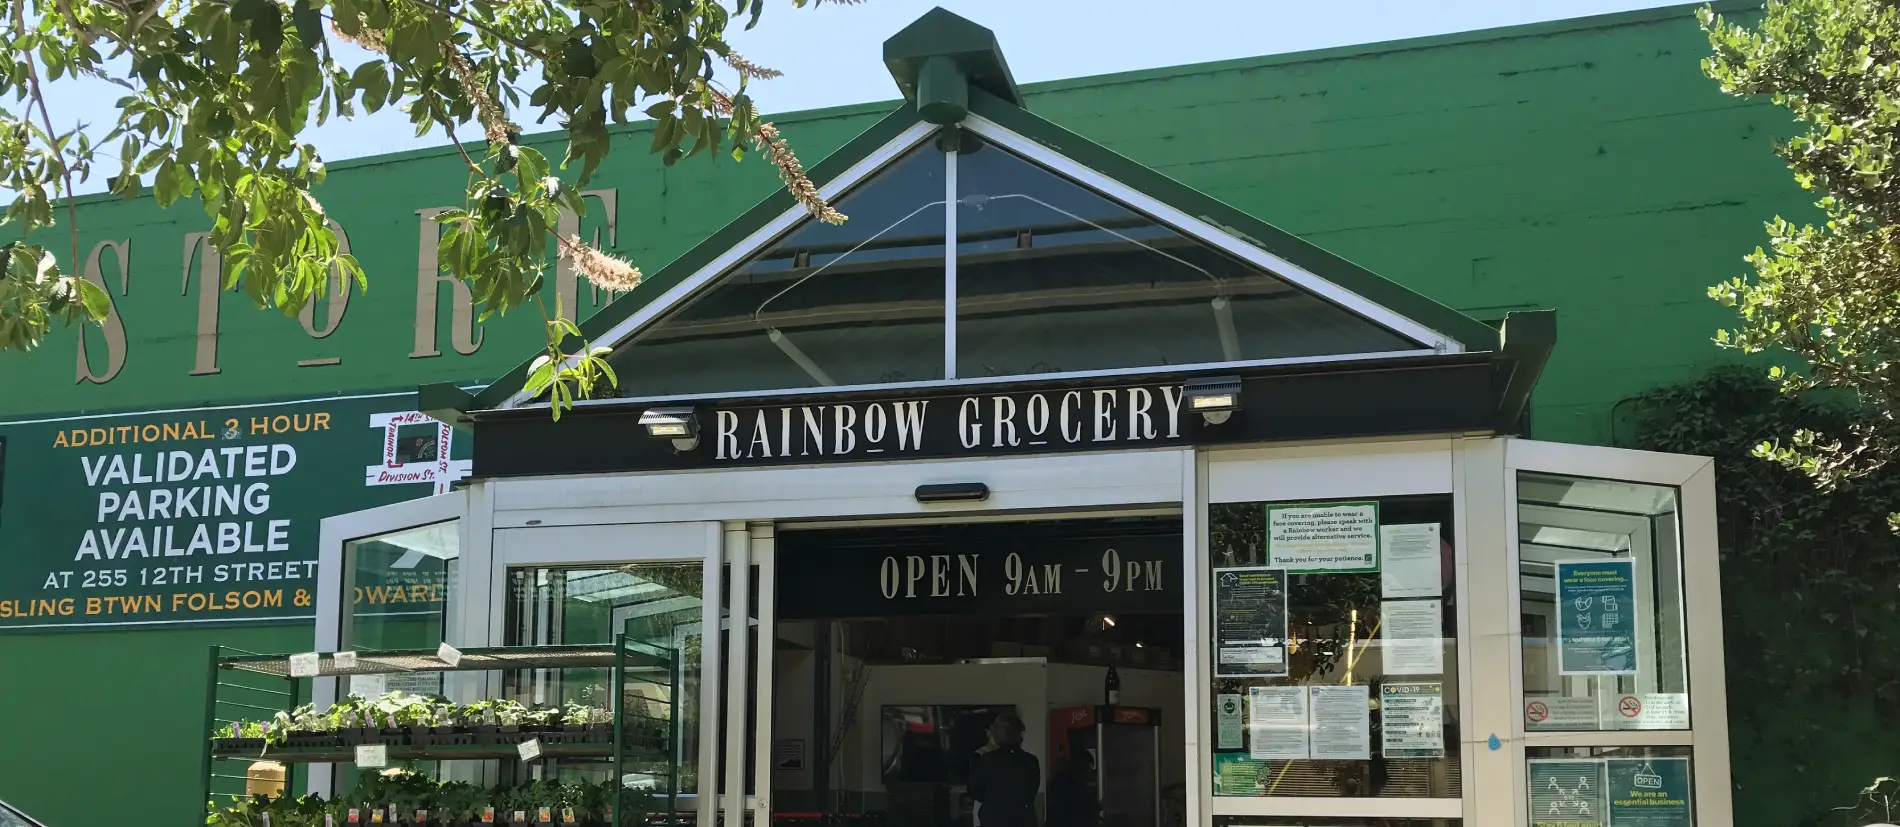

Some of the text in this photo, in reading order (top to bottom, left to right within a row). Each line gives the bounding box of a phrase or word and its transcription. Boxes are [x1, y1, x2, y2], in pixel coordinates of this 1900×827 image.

[53, 412, 331, 448] ADDITIONAL 3 HOUR
[386, 422, 396, 458] TRAINOR
[715, 384, 1186, 460] RAINBOW GROCERY
[440, 424, 450, 460] FOLSOM
[81, 443, 297, 486] VALIDATED
[98, 482, 270, 522] PARKING
[74, 519, 290, 561] AVAILABLE
[42, 560, 318, 589] AT 255 12TH STREET
[880, 553, 980, 599] OPEN
[1004, 552, 1062, 597] 9AM
[1102, 548, 1163, 594] 9PM
[86, 594, 162, 615] BTWN
[172, 589, 282, 611] FOLSOM
[294, 588, 311, 607] &
[1636, 777, 1660, 786] OPEN
